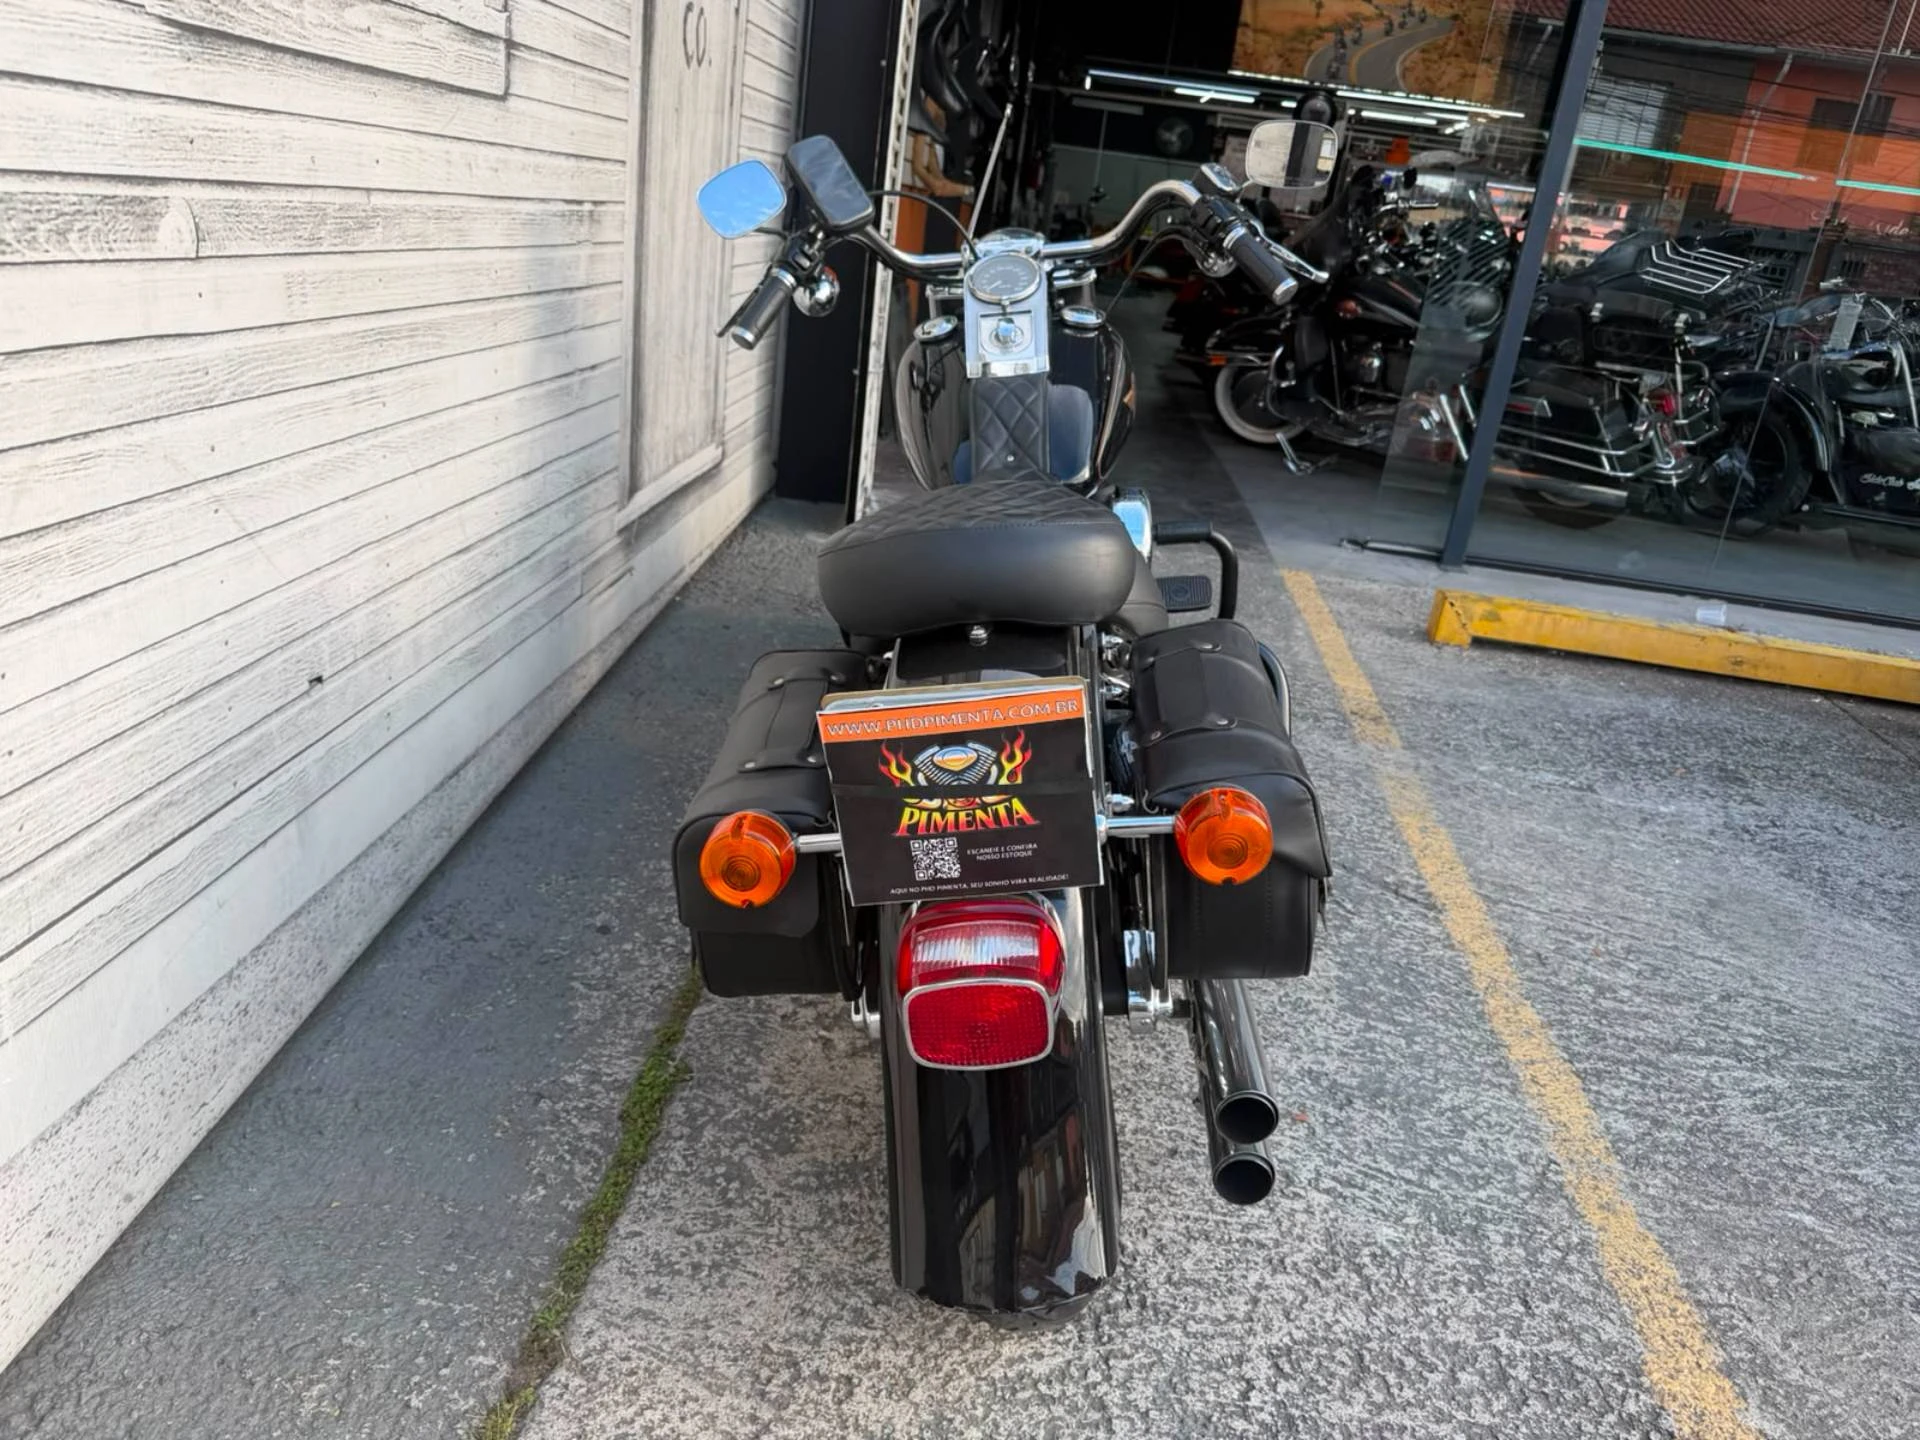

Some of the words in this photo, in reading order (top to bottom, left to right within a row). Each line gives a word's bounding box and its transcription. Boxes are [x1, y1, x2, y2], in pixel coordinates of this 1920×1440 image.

[893, 797, 1041, 836] PIMENTA
[1006, 843, 1038, 851] CONFIRA
[1001, 850, 1032, 859] ESTOQUE
[984, 879, 1009, 887] SONHO
